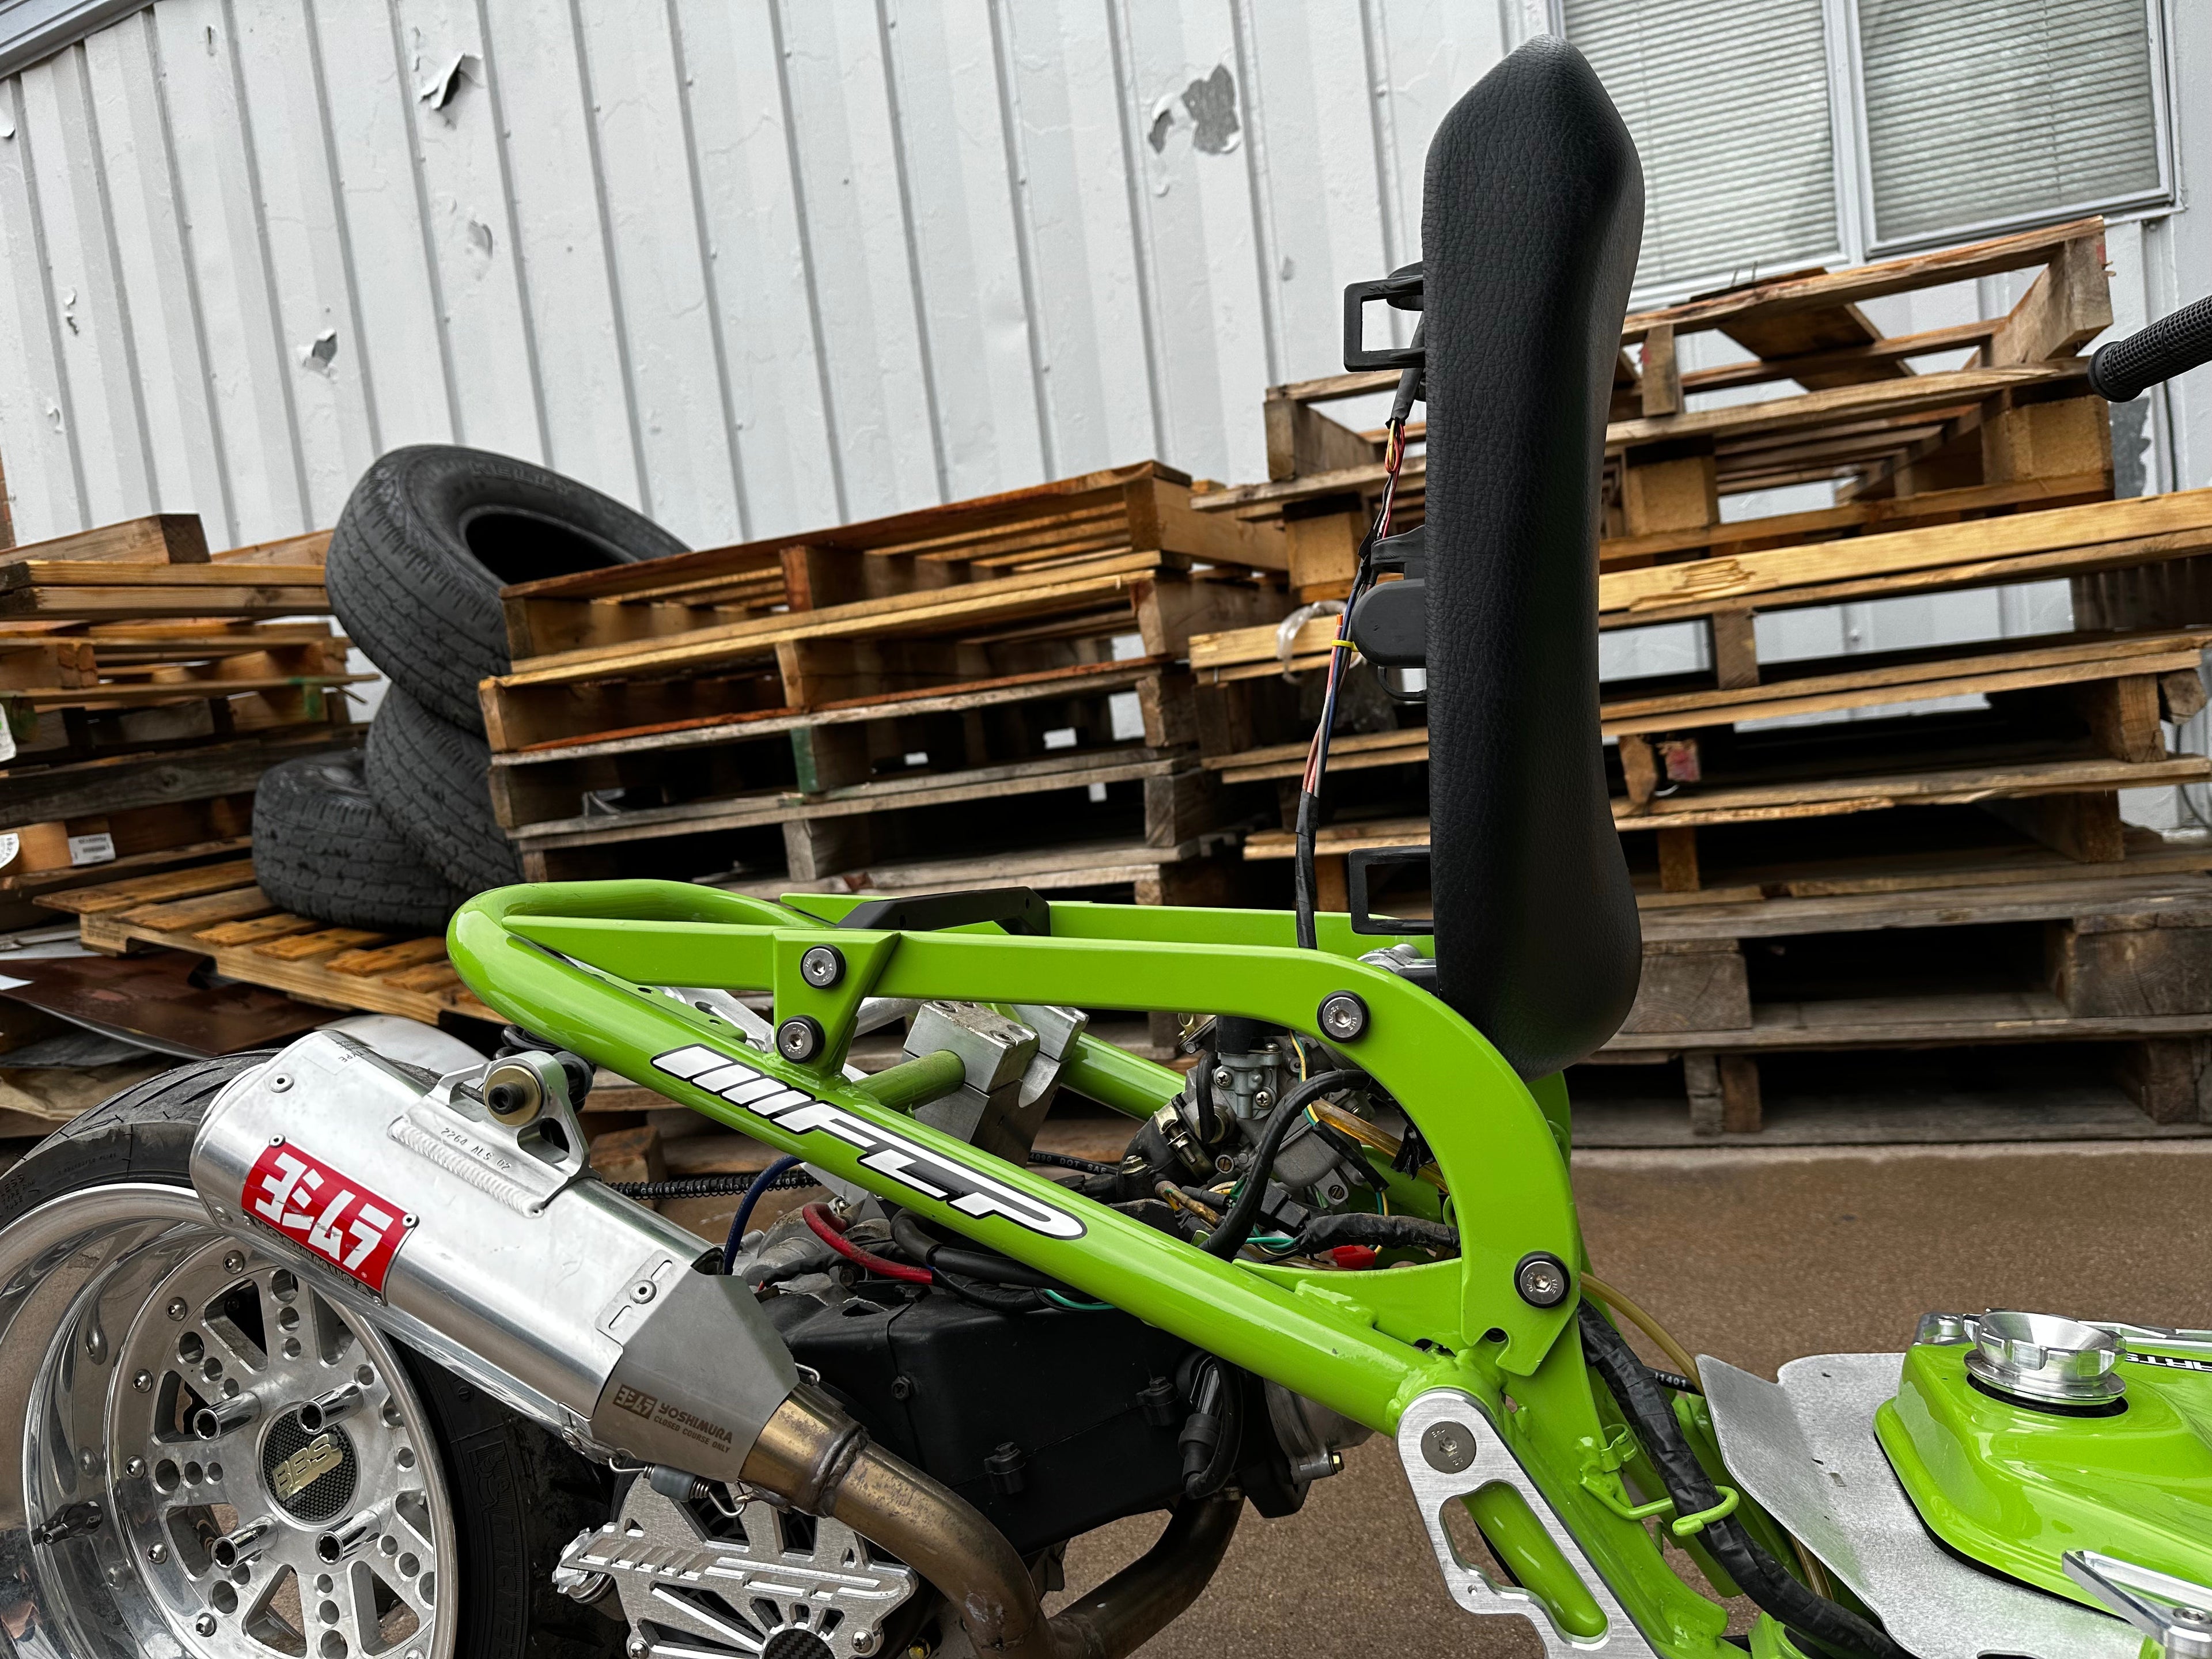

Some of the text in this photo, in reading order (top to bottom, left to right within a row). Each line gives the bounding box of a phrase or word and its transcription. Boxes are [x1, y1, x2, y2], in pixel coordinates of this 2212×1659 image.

[1059, 1157, 1080, 1168] DOT
[1087, 1163, 1108, 1175] SAE
[255, 1153, 394, 1271] ヨシムラ
[616, 1388, 655, 1416] ヨシムラ
[654, 1415, 730, 1454] CLOSED COURSE ONLY
[658, 1403, 733, 1444] YOSHIMURA
[272, 1433, 335, 1498] BBS
